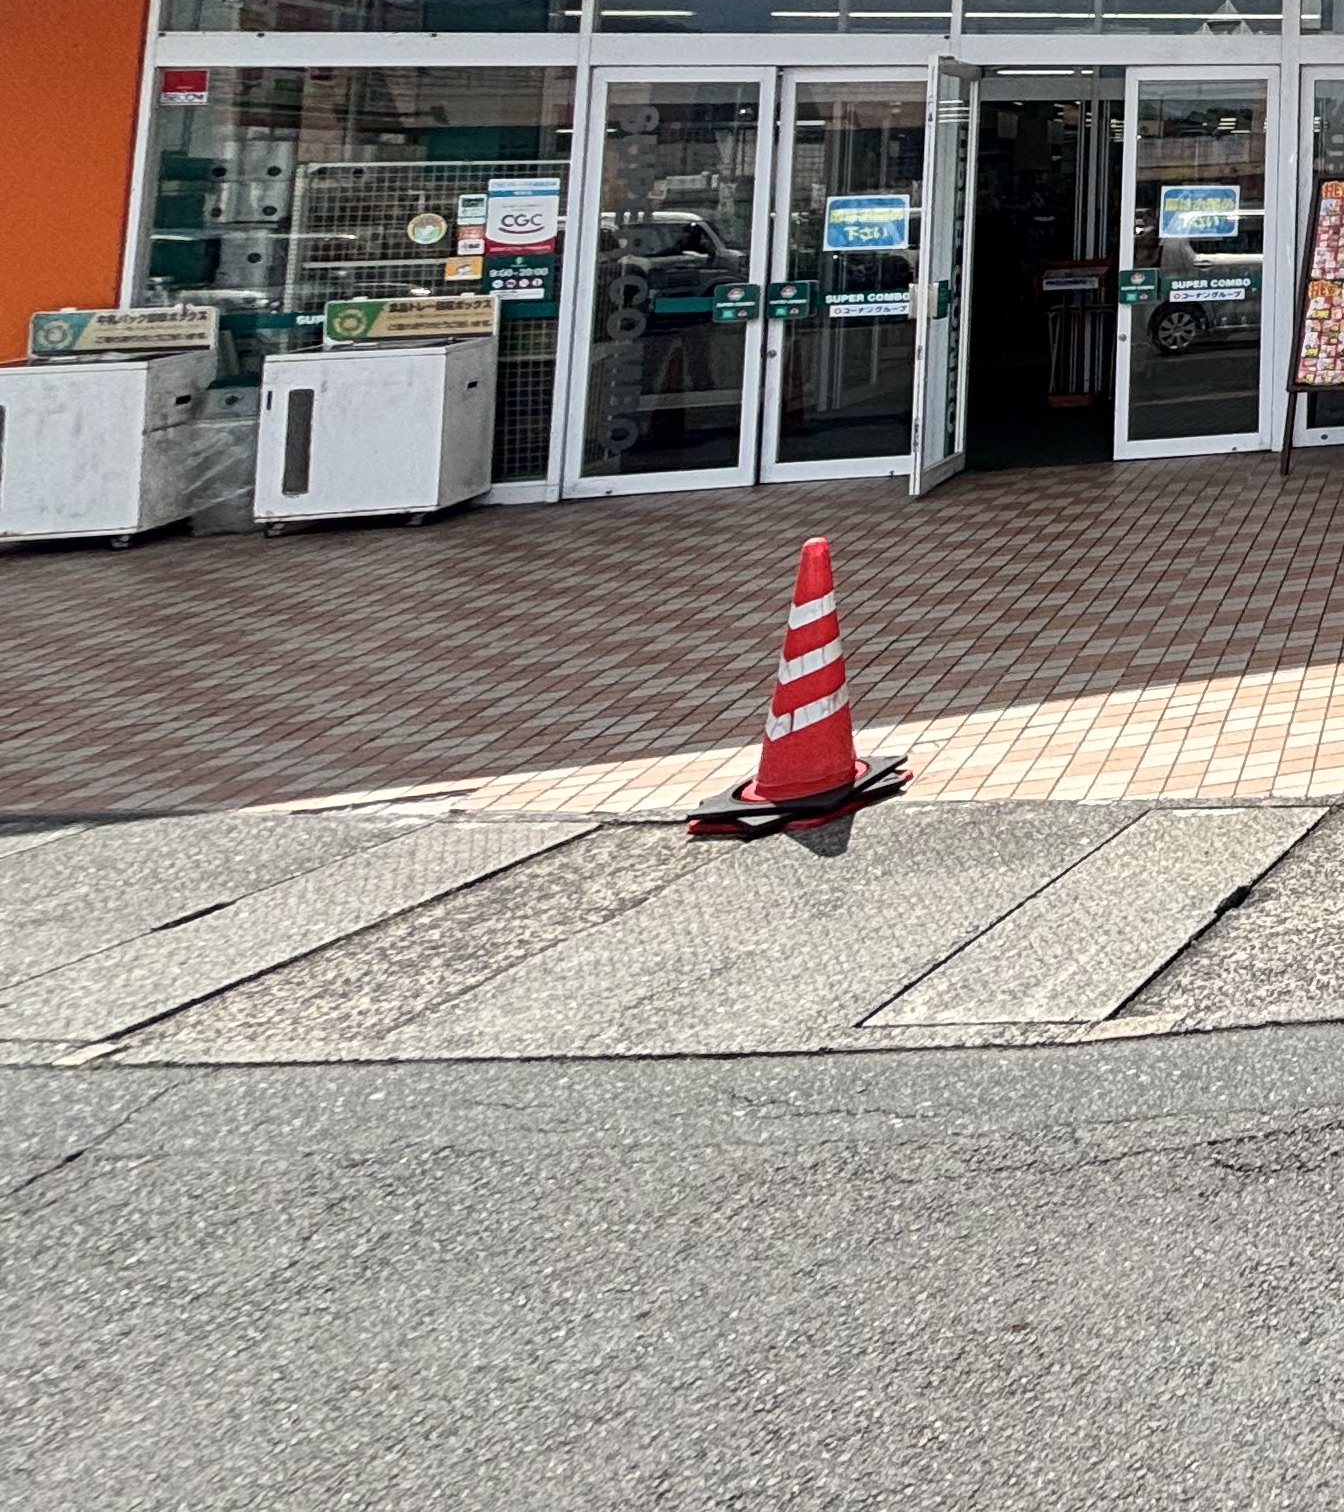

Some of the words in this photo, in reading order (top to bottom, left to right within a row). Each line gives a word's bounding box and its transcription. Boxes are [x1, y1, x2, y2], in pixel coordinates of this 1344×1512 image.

[501, 214, 543, 227] CGC
[1171, 280, 1208, 289] SUPER
[1210, 278, 1251, 288] COMBO
[825, 293, 865, 304] SUPER
[867, 292, 910, 302] COMBO
